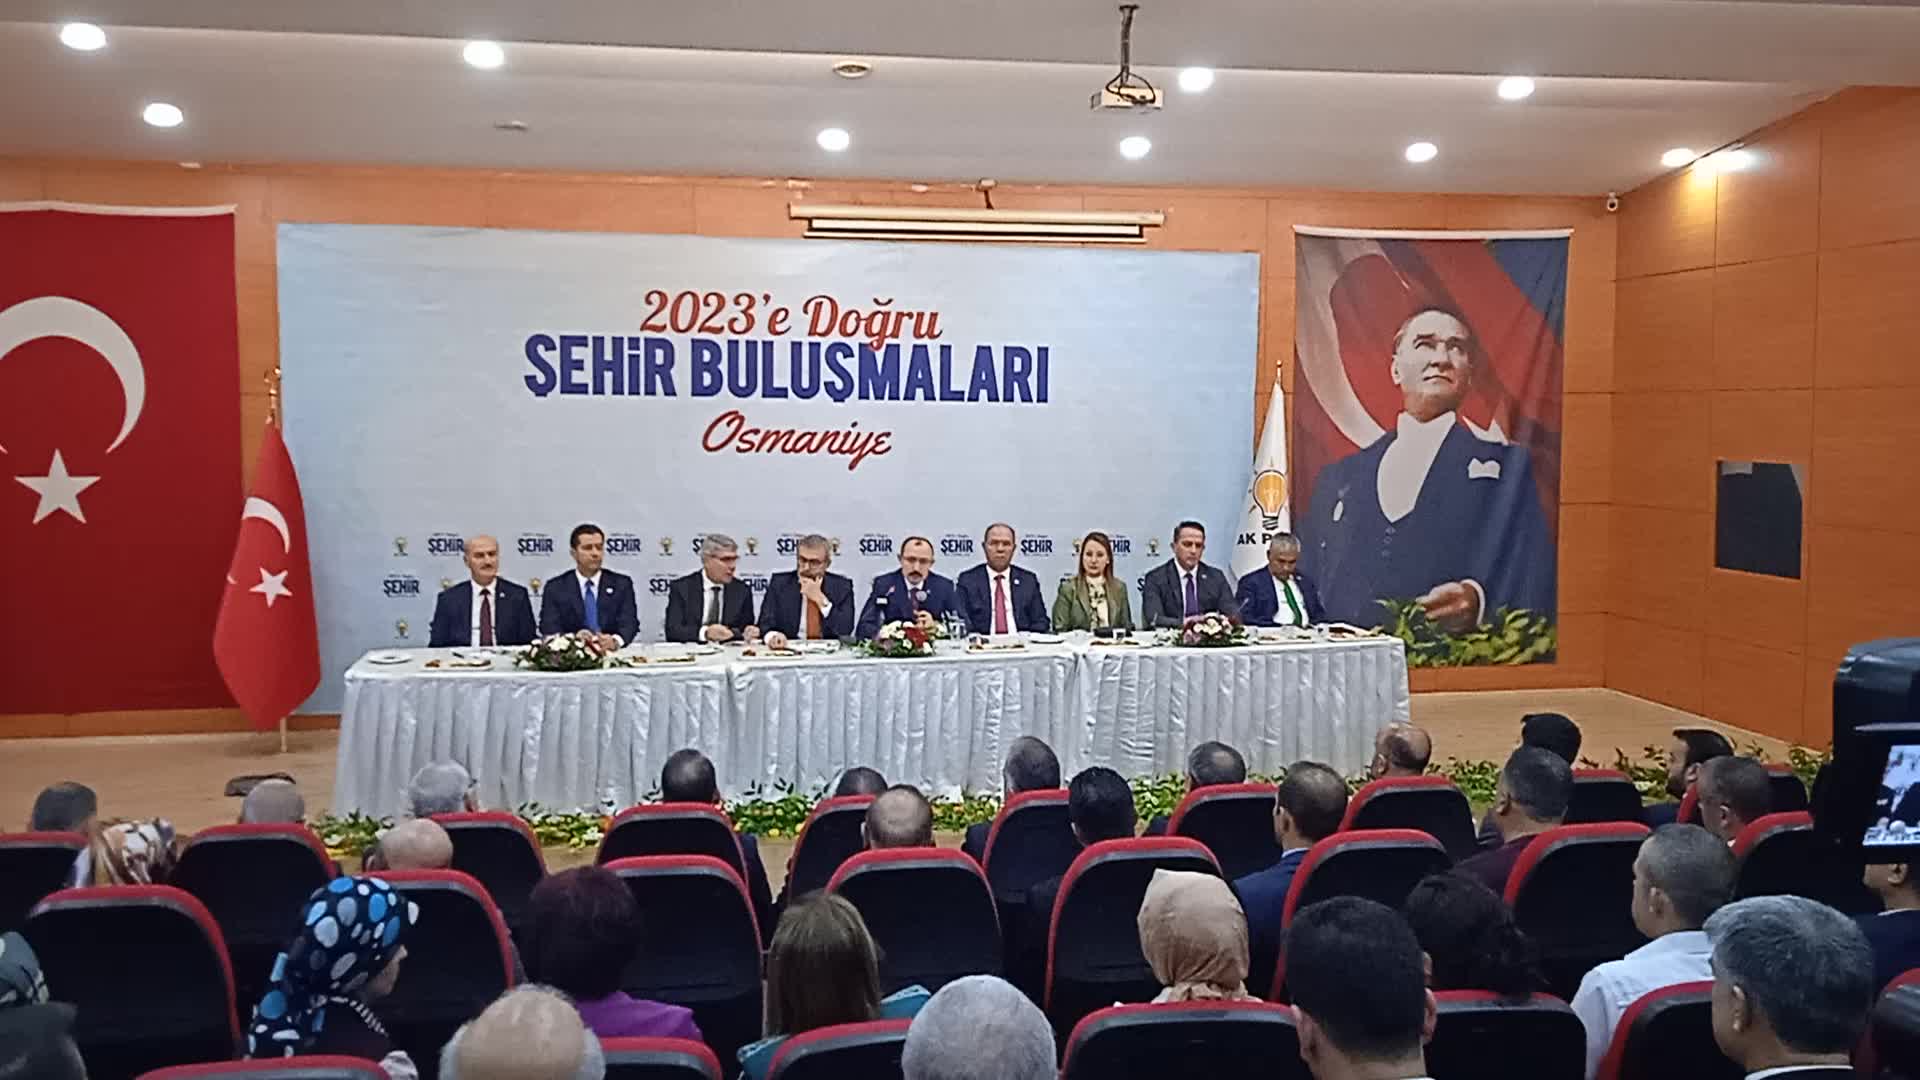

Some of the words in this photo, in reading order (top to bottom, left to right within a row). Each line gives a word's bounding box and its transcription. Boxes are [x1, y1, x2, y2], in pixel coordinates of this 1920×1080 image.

[639, 290, 792, 336] 2023'e
[802, 295, 944, 350] Doğru
[524, 333, 678, 399] ŞEHİR
[690, 338, 1050, 405] BULUŞMALARI
[701, 410, 893, 471] Osmaniye
[1237, 533, 1257, 545] AK
